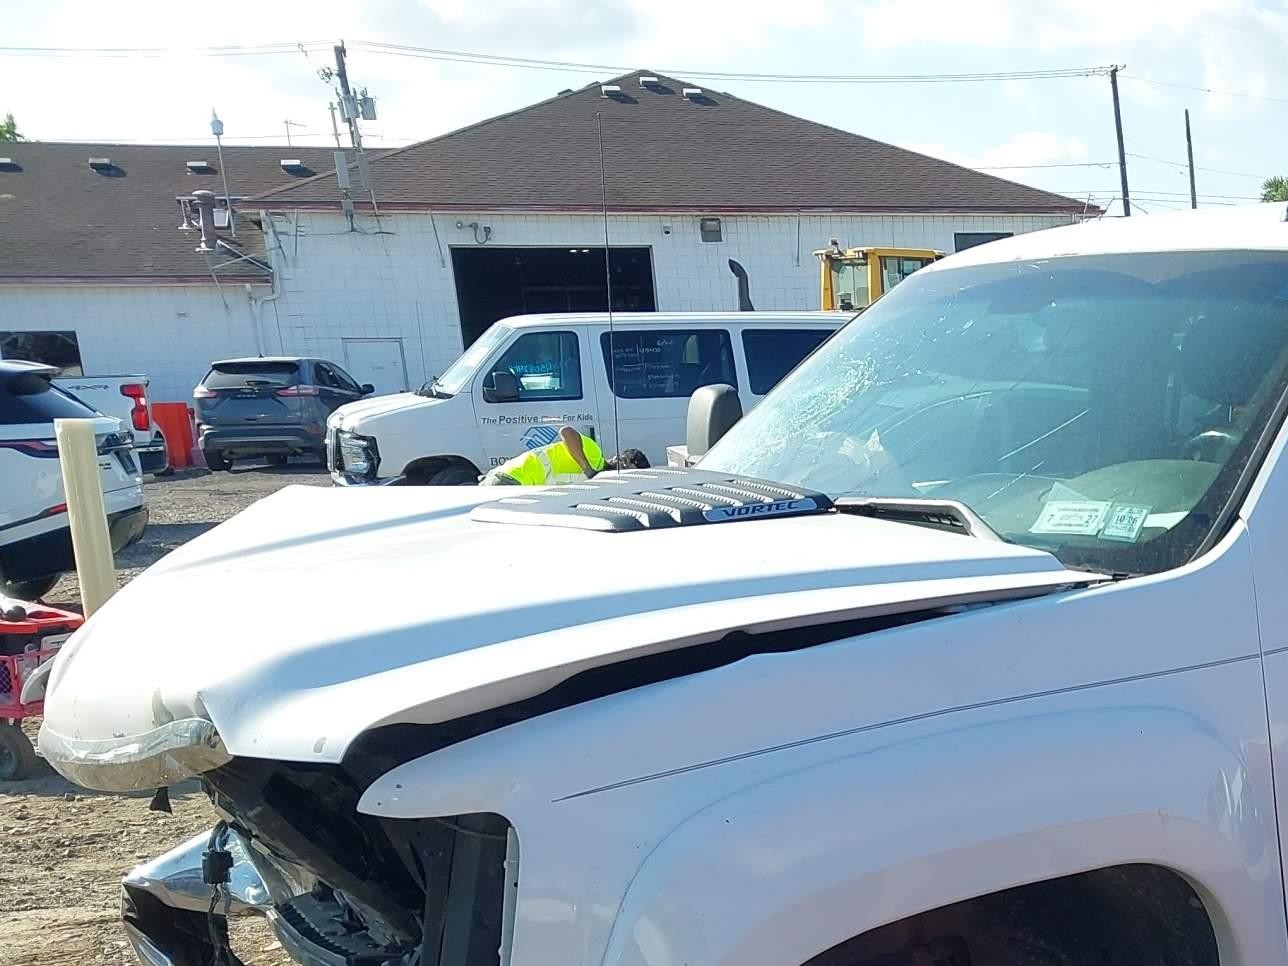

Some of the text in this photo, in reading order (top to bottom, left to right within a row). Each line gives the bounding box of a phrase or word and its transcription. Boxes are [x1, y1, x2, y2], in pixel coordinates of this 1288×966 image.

[482, 417, 497, 425] The
[498, 414, 539, 425] Positive
[562, 414, 575, 423] For
[576, 412, 594, 423] Kids
[722, 501, 799, 517] VORTEC
